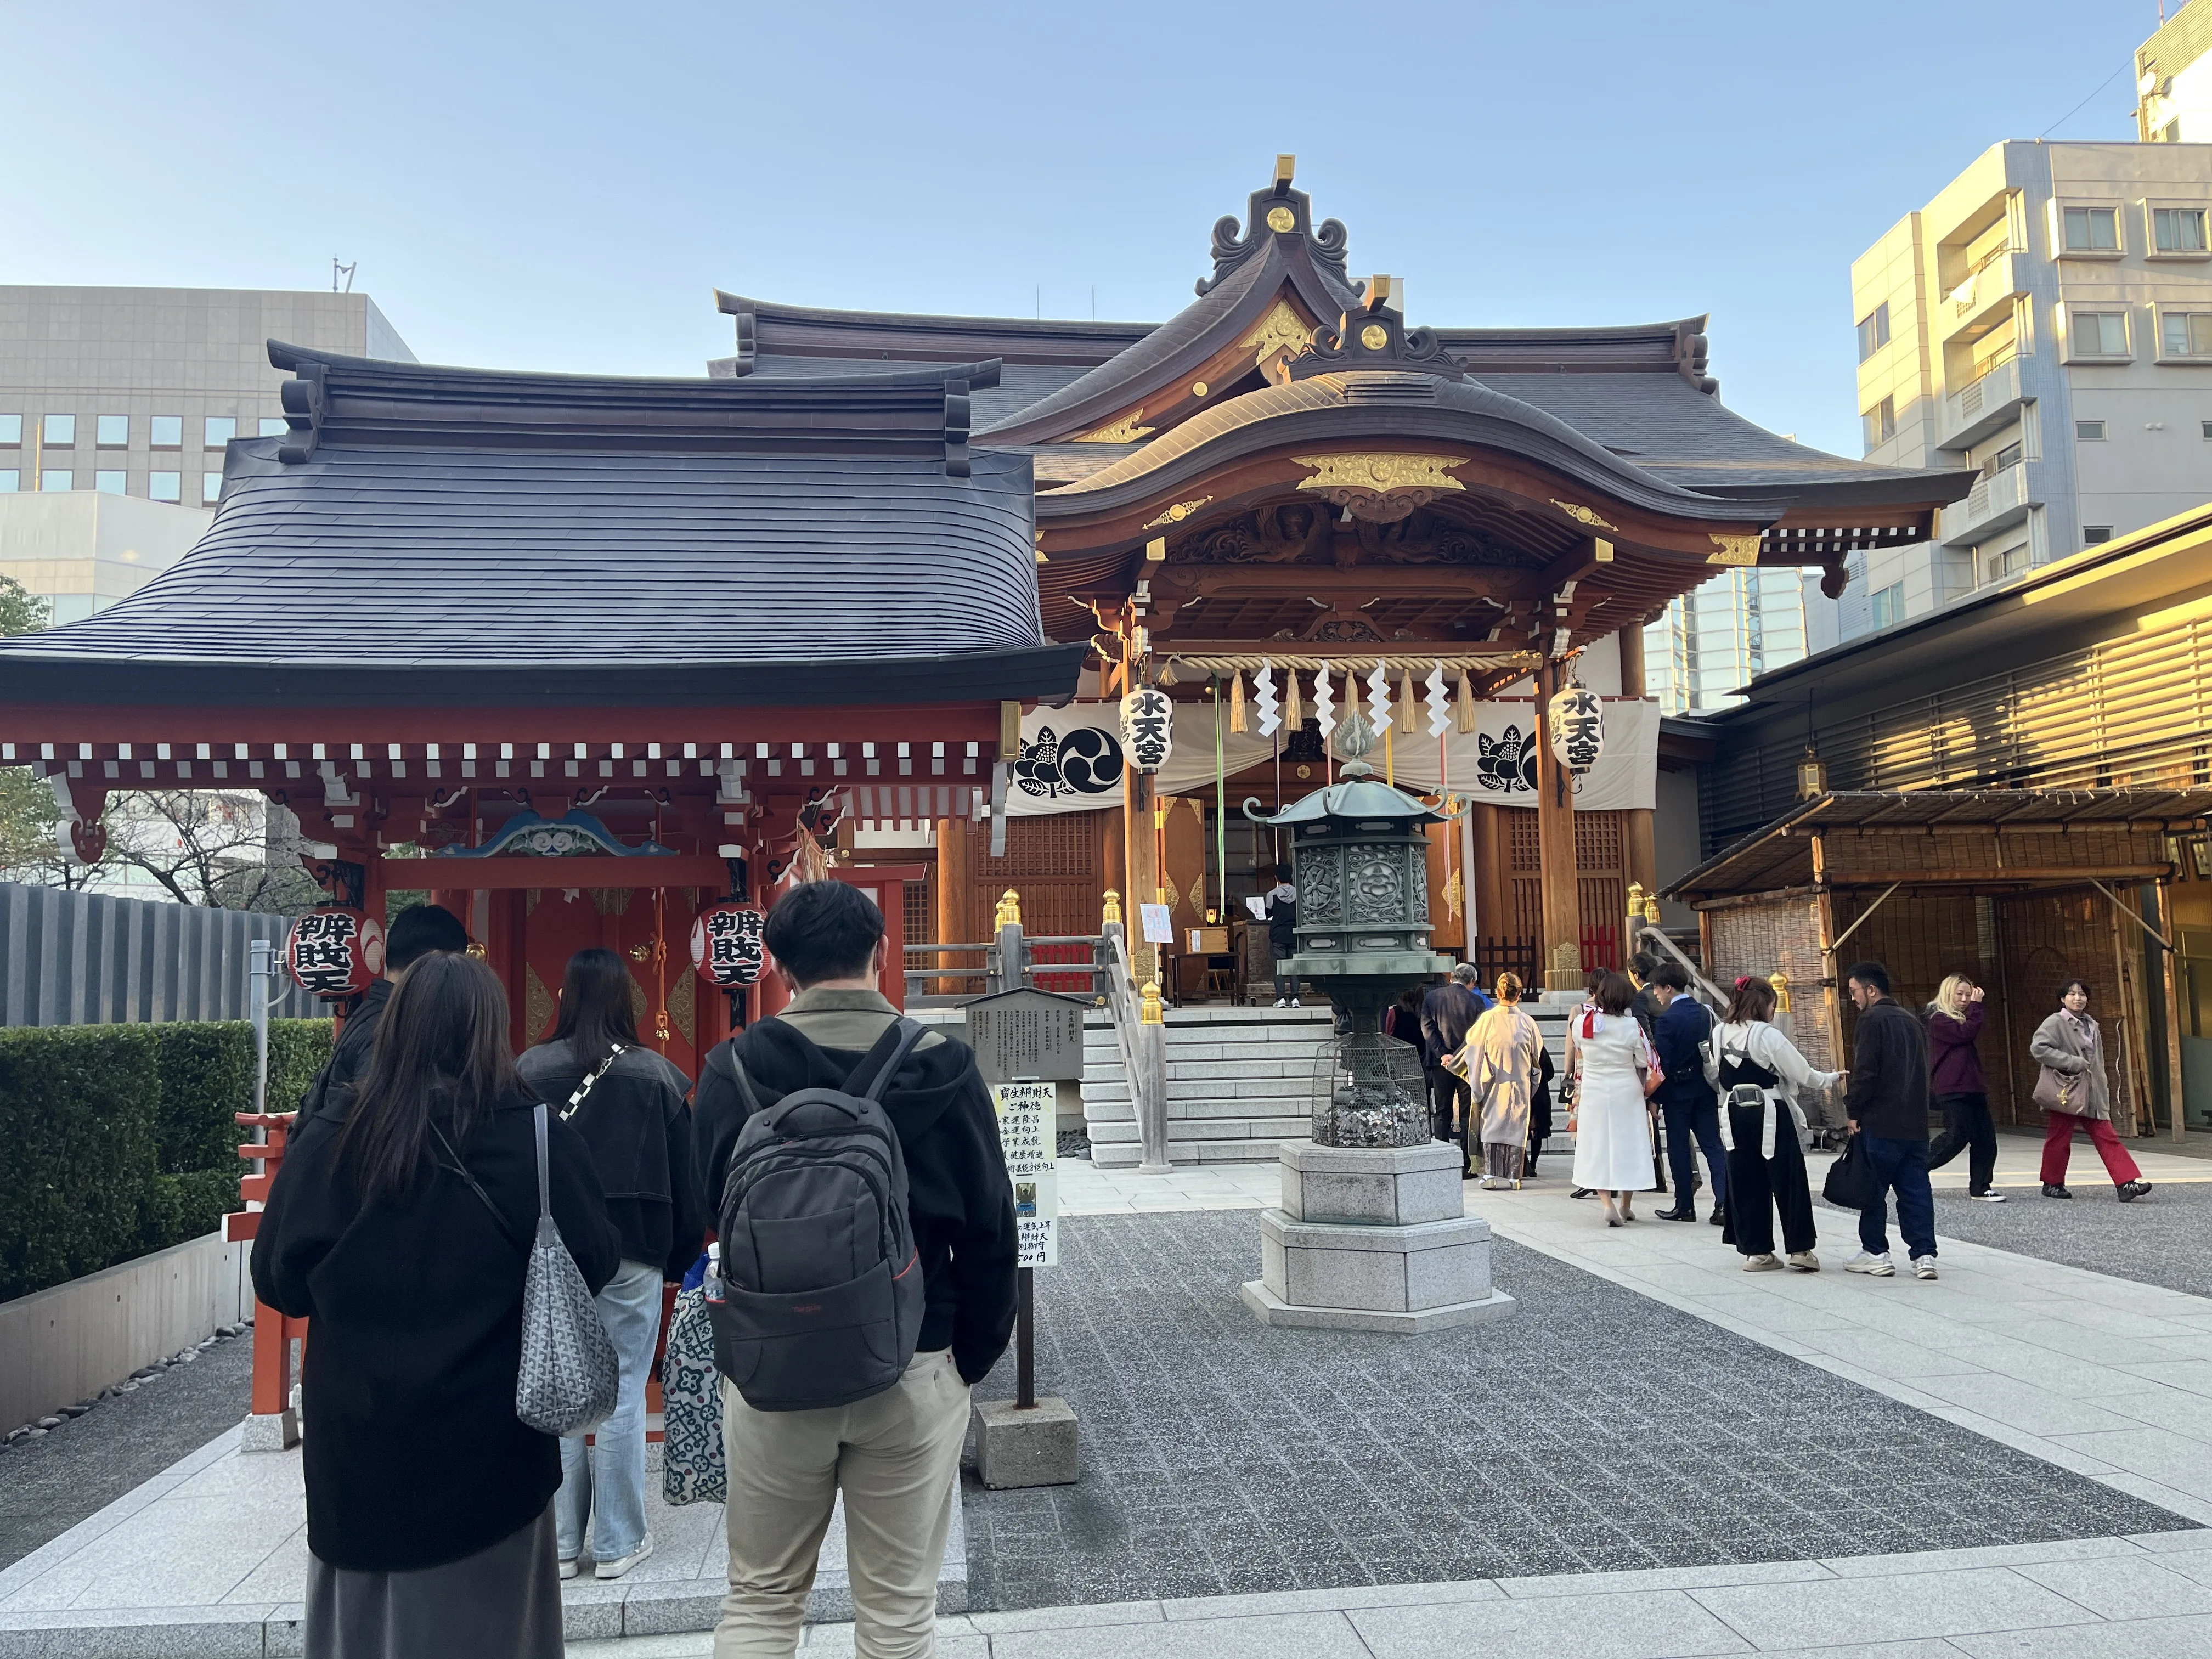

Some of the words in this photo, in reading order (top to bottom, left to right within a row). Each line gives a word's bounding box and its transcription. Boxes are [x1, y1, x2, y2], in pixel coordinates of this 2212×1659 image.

[1130, 693, 1167, 764] 水天宮
[1562, 692, 1600, 764] 水天宮
[1002, 1126, 1040, 1135] 金運向上
[1019, 1233, 1048, 1242] 辨財天
